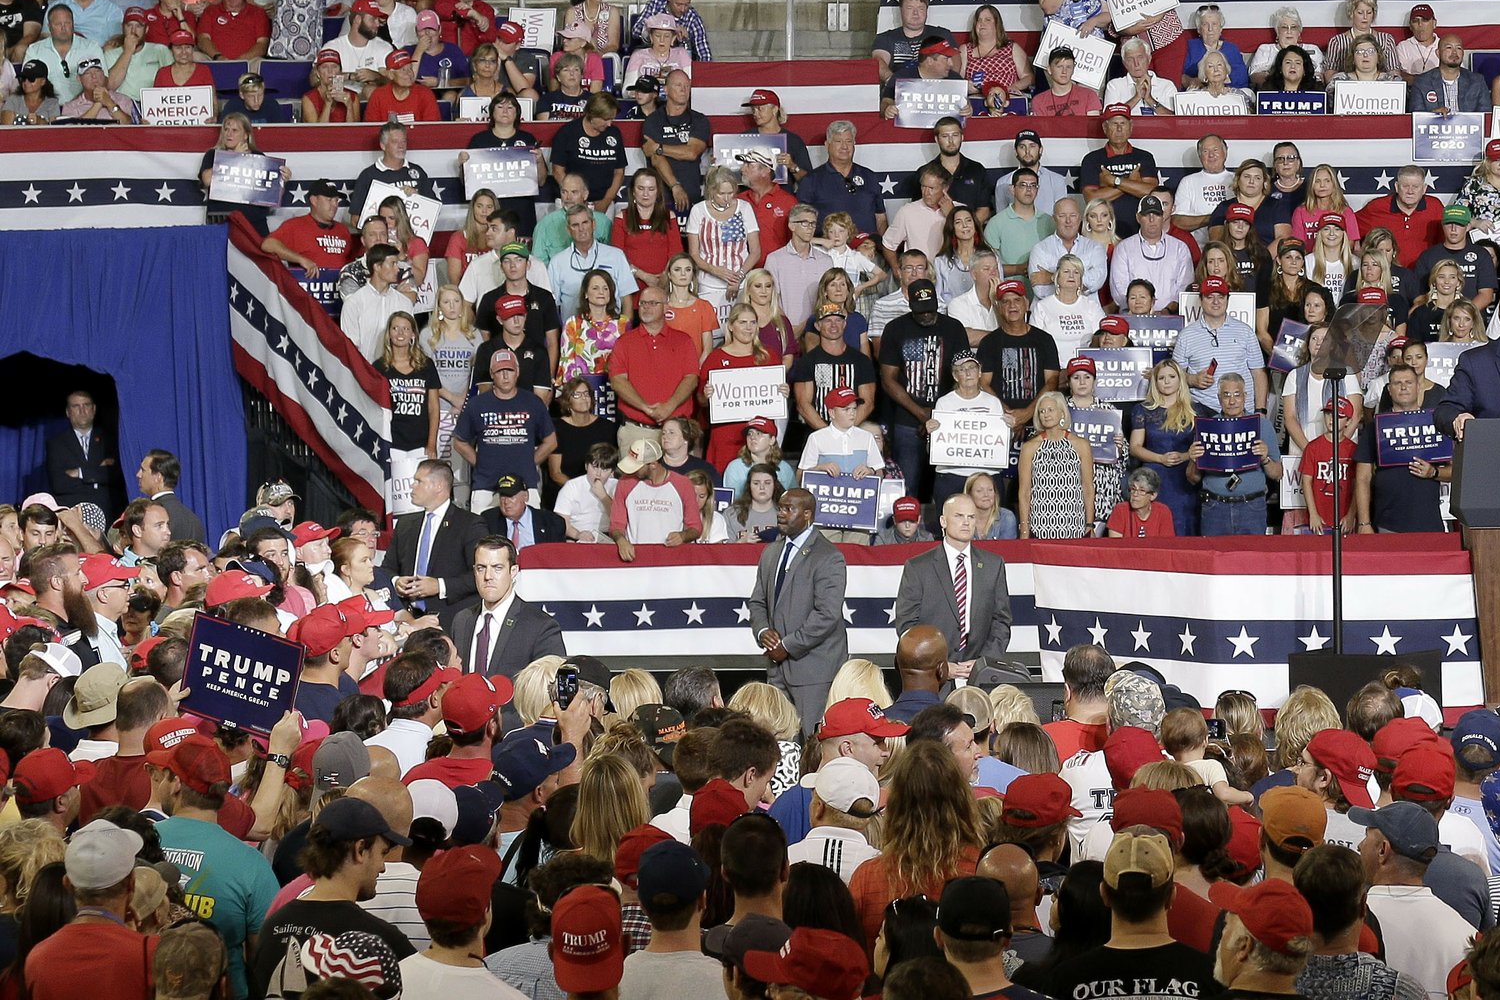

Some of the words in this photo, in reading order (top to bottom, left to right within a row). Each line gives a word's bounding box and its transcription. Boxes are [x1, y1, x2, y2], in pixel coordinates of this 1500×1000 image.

[1121, 4, 1137, 16] FOR
[161, 95, 191, 104] KEEP
[903, 94, 961, 103] TRUMP
[1340, 94, 1400, 109] Women
[905, 102, 955, 110] PENCE
[1262, 101, 1321, 110] TRUMP
[148, 106, 208, 117] AMERICA
[155, 118, 201, 126] GREAT!
[1417, 125, 1479, 135] TRUMP
[1432, 141, 1465, 150] 2020
[580, 148, 615, 156] TRUMP
[470, 160, 531, 172] TRUMP
[219, 165, 279, 181] TRUMP
[477, 170, 526, 180] PENCE
[223, 175, 272, 188] PENCE
[316, 237, 346, 248] TRUMP
[434, 350, 471, 361] TRUMP
[389, 378, 426, 389] WOMEN
[1099, 378, 1133, 388] 2020
[716, 382, 779, 399] Women
[744, 399, 773, 407] TRUMP
[395, 403, 420, 416] 2020
[480, 413, 530, 425] TRUMP
[954, 421, 987, 430] KEEP
[502, 428, 528, 436] SEQUEL
[1201, 431, 1256, 442] TRUMP
[1384, 426, 1437, 438] TRUM
[936, 433, 1004, 445] AMERICA
[1390, 436, 1442, 446] PENCE
[1205, 442, 1251, 450] PENCE
[946, 448, 994, 458] GREAT!
[806, 485, 875, 499] TRUMP
[821, 503, 857, 514] 2020
[200, 644, 291, 684] TRUMP
[203, 668, 279, 700] PENCE
[206, 682, 223, 693] KEEP
[223, 687, 248, 701] AMERICA
[248, 696, 270, 708] GREAT!
[224, 720, 237, 728] 2020
[273, 924, 302, 937] Sailing
[563, 930, 606, 946] TRUMP
[1074, 980, 1126, 999] OUR
[1134, 980, 1199, 998] FLAG
